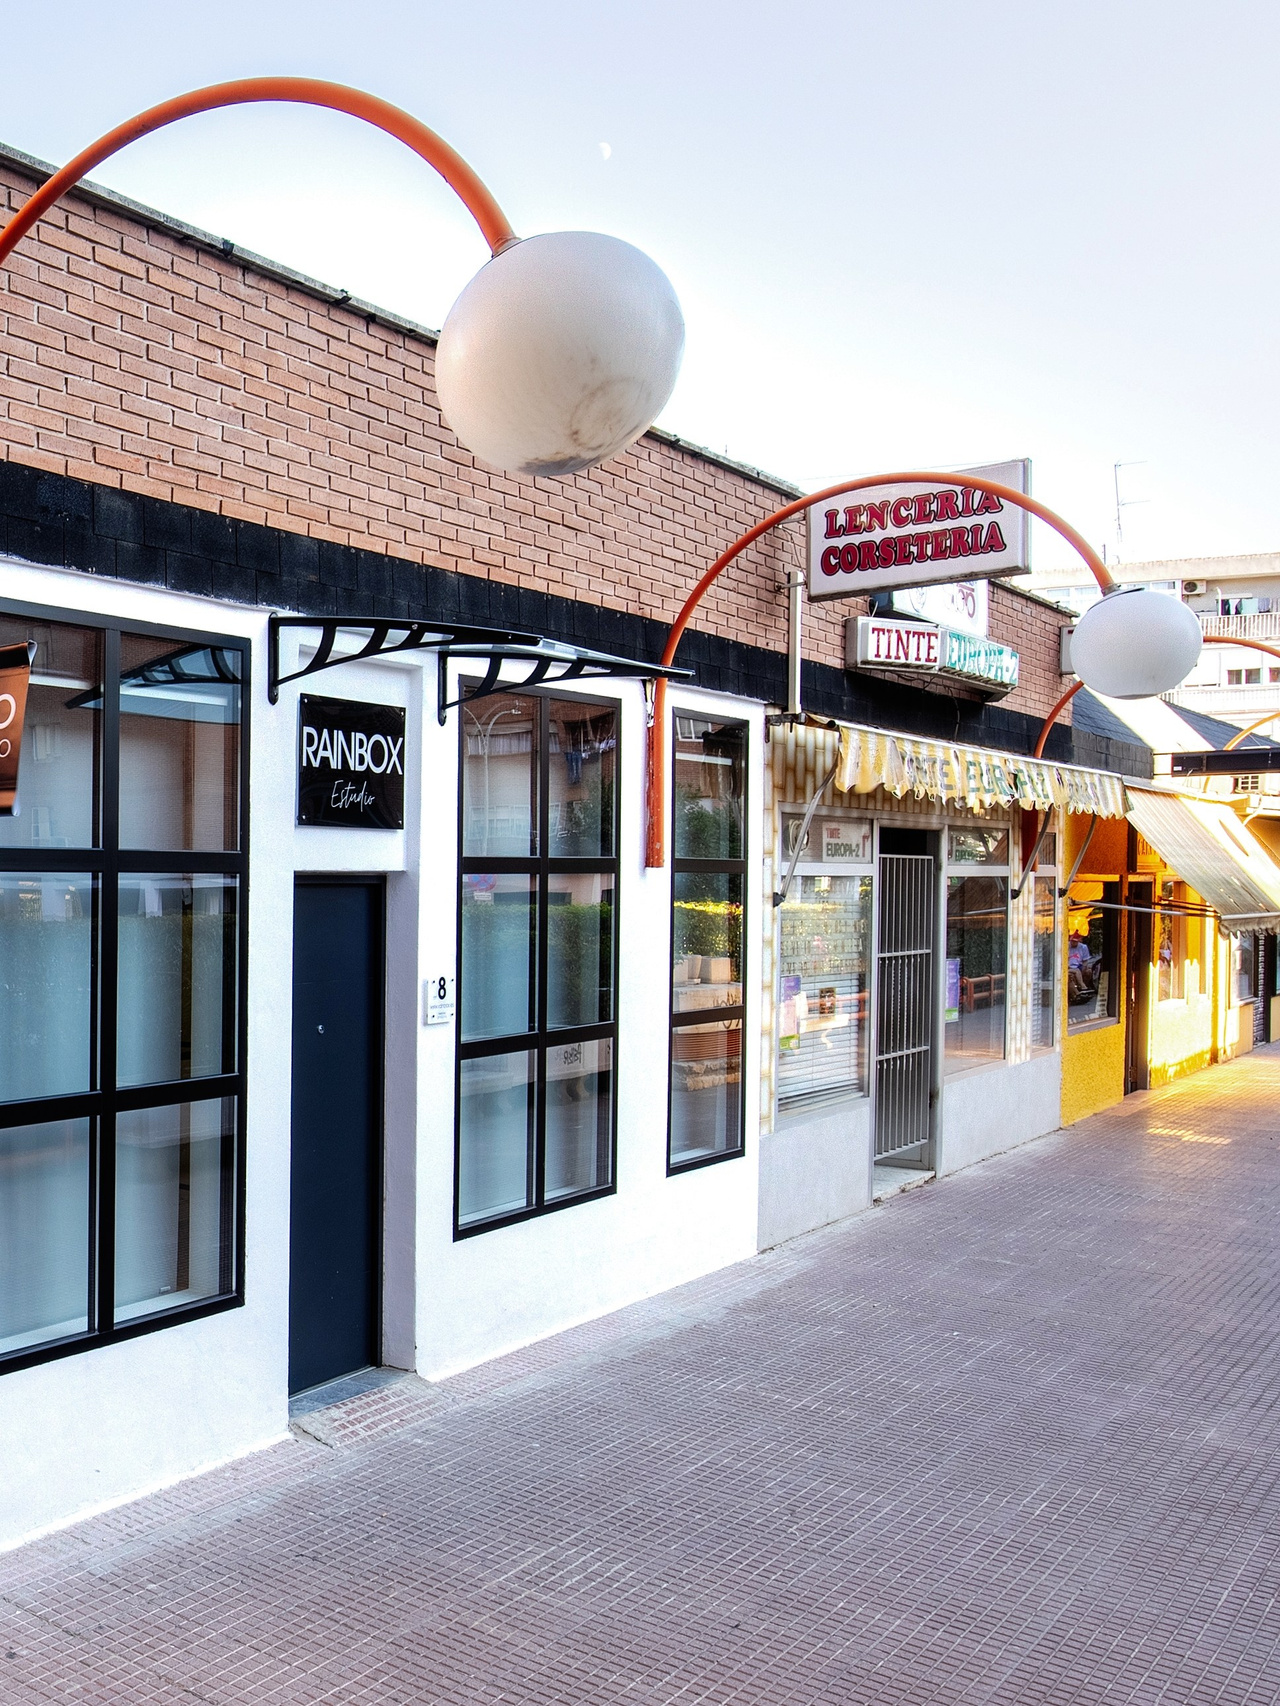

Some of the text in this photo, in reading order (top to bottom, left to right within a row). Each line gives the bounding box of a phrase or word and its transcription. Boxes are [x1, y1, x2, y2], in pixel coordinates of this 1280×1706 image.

[824, 487, 1003, 539] LENCERIA
[821, 521, 1007, 576] CORSETERIA
[872, 627, 938, 664] TINTE
[302, 725, 404, 775] RAINBOX
[331, 780, 376, 812] Estudio
[826, 842, 860, 858] EUROPA-2
[437, 976, 447, 1000] 8
